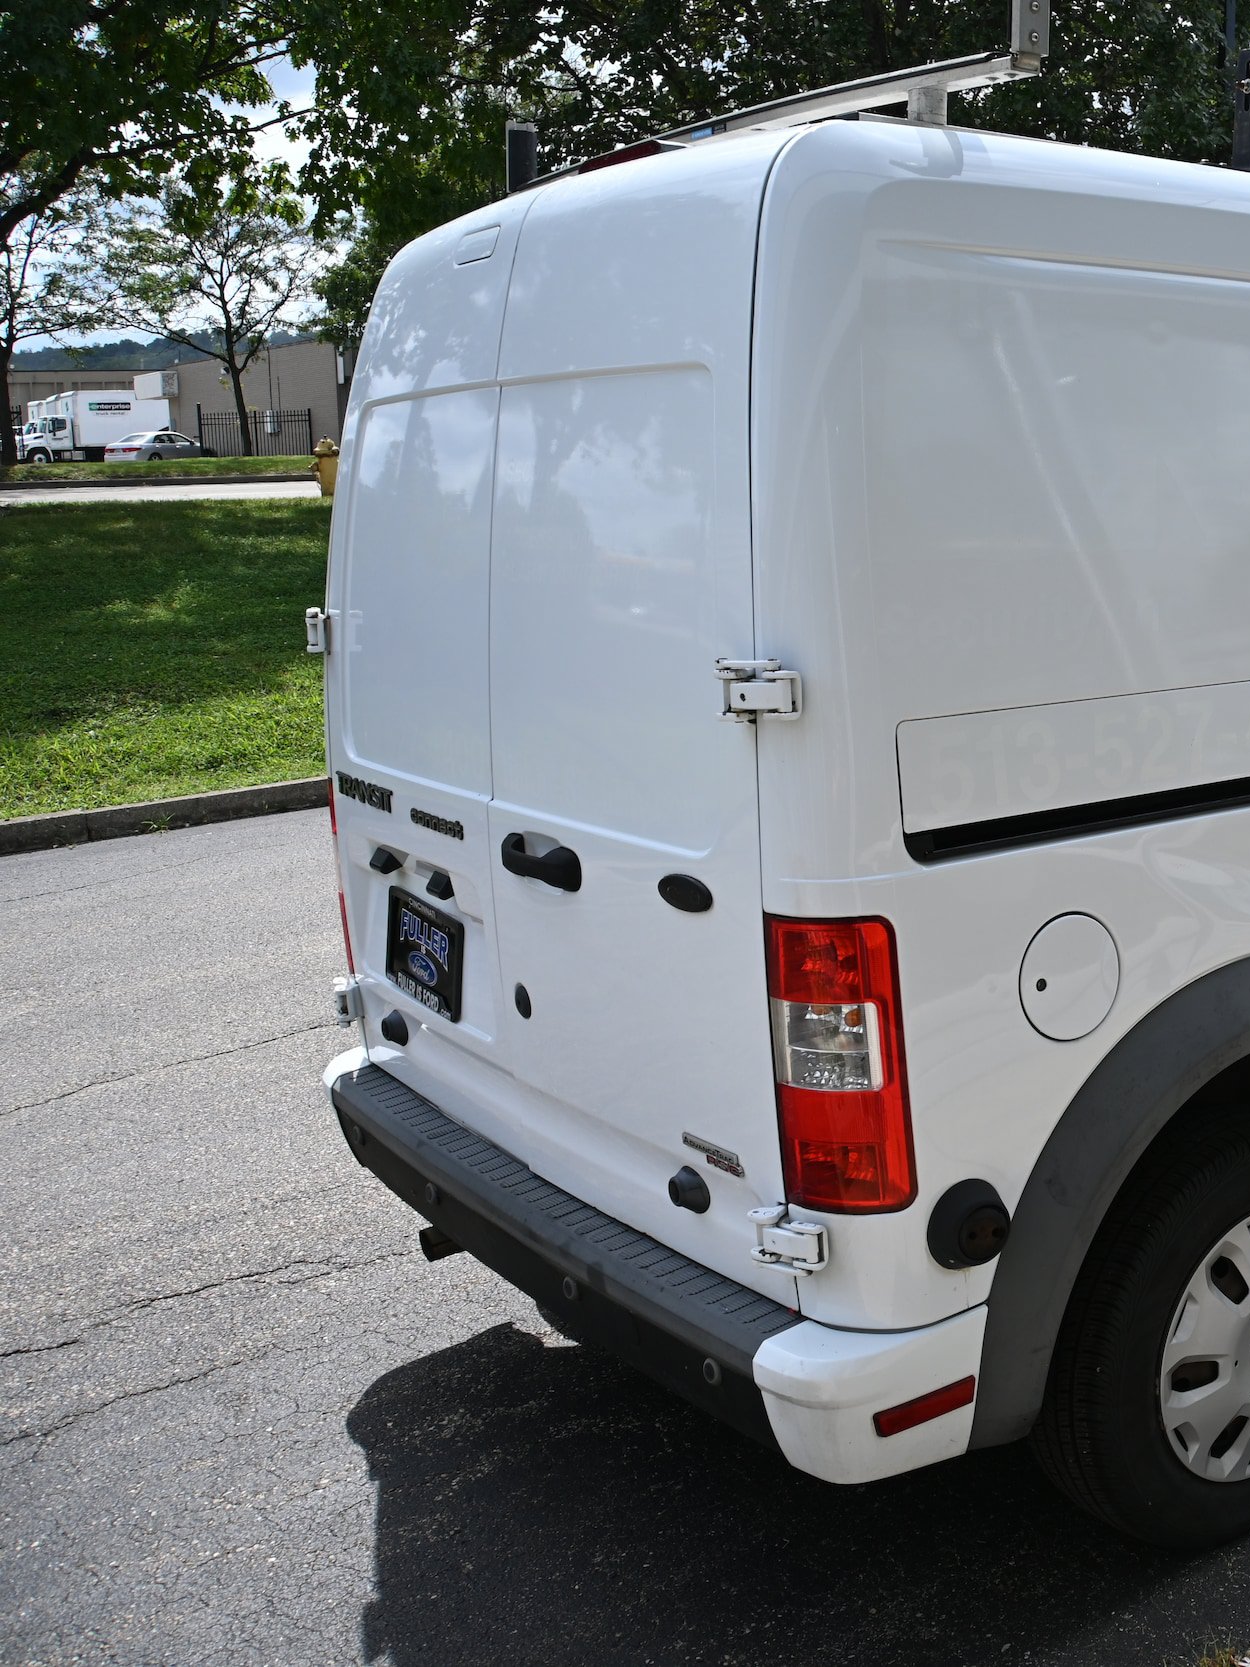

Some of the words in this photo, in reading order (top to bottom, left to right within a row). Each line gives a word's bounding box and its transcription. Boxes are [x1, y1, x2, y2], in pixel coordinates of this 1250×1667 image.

[90, 403, 131, 411] enterprise
[335, 770, 393, 814] TRANSIT
[410, 807, 464, 841] connect
[400, 907, 449, 972] FULLER
[397, 971, 416, 999] FULLER
[416, 984, 422, 1000] IS
[422, 988, 439, 1012] FORD
